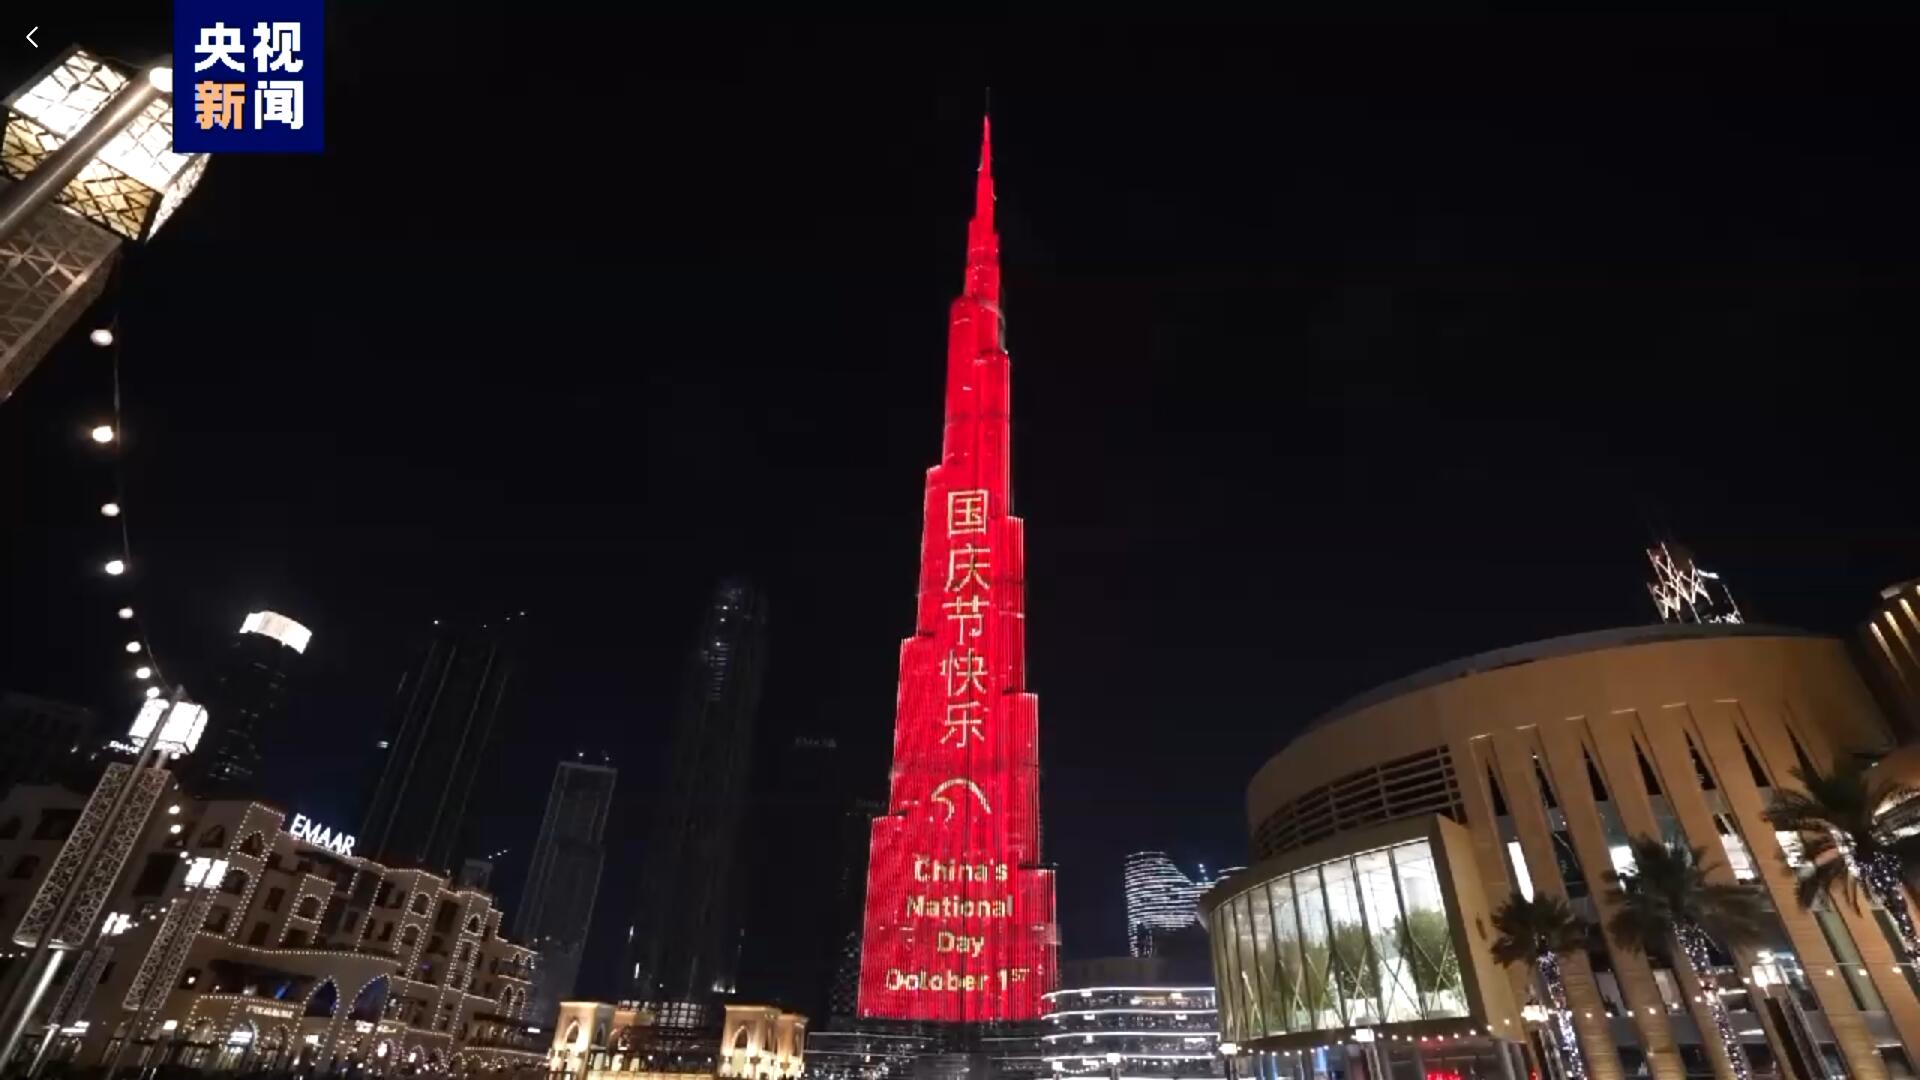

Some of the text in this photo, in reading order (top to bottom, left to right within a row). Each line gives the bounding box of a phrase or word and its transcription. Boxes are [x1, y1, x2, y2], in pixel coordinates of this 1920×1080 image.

[938, 488, 990, 748] 国庆节快乐
[289, 812, 356, 856] EMAAR
[913, 857, 1008, 883] China's
[906, 894, 1014, 918] National
[936, 931, 985, 957] Day
